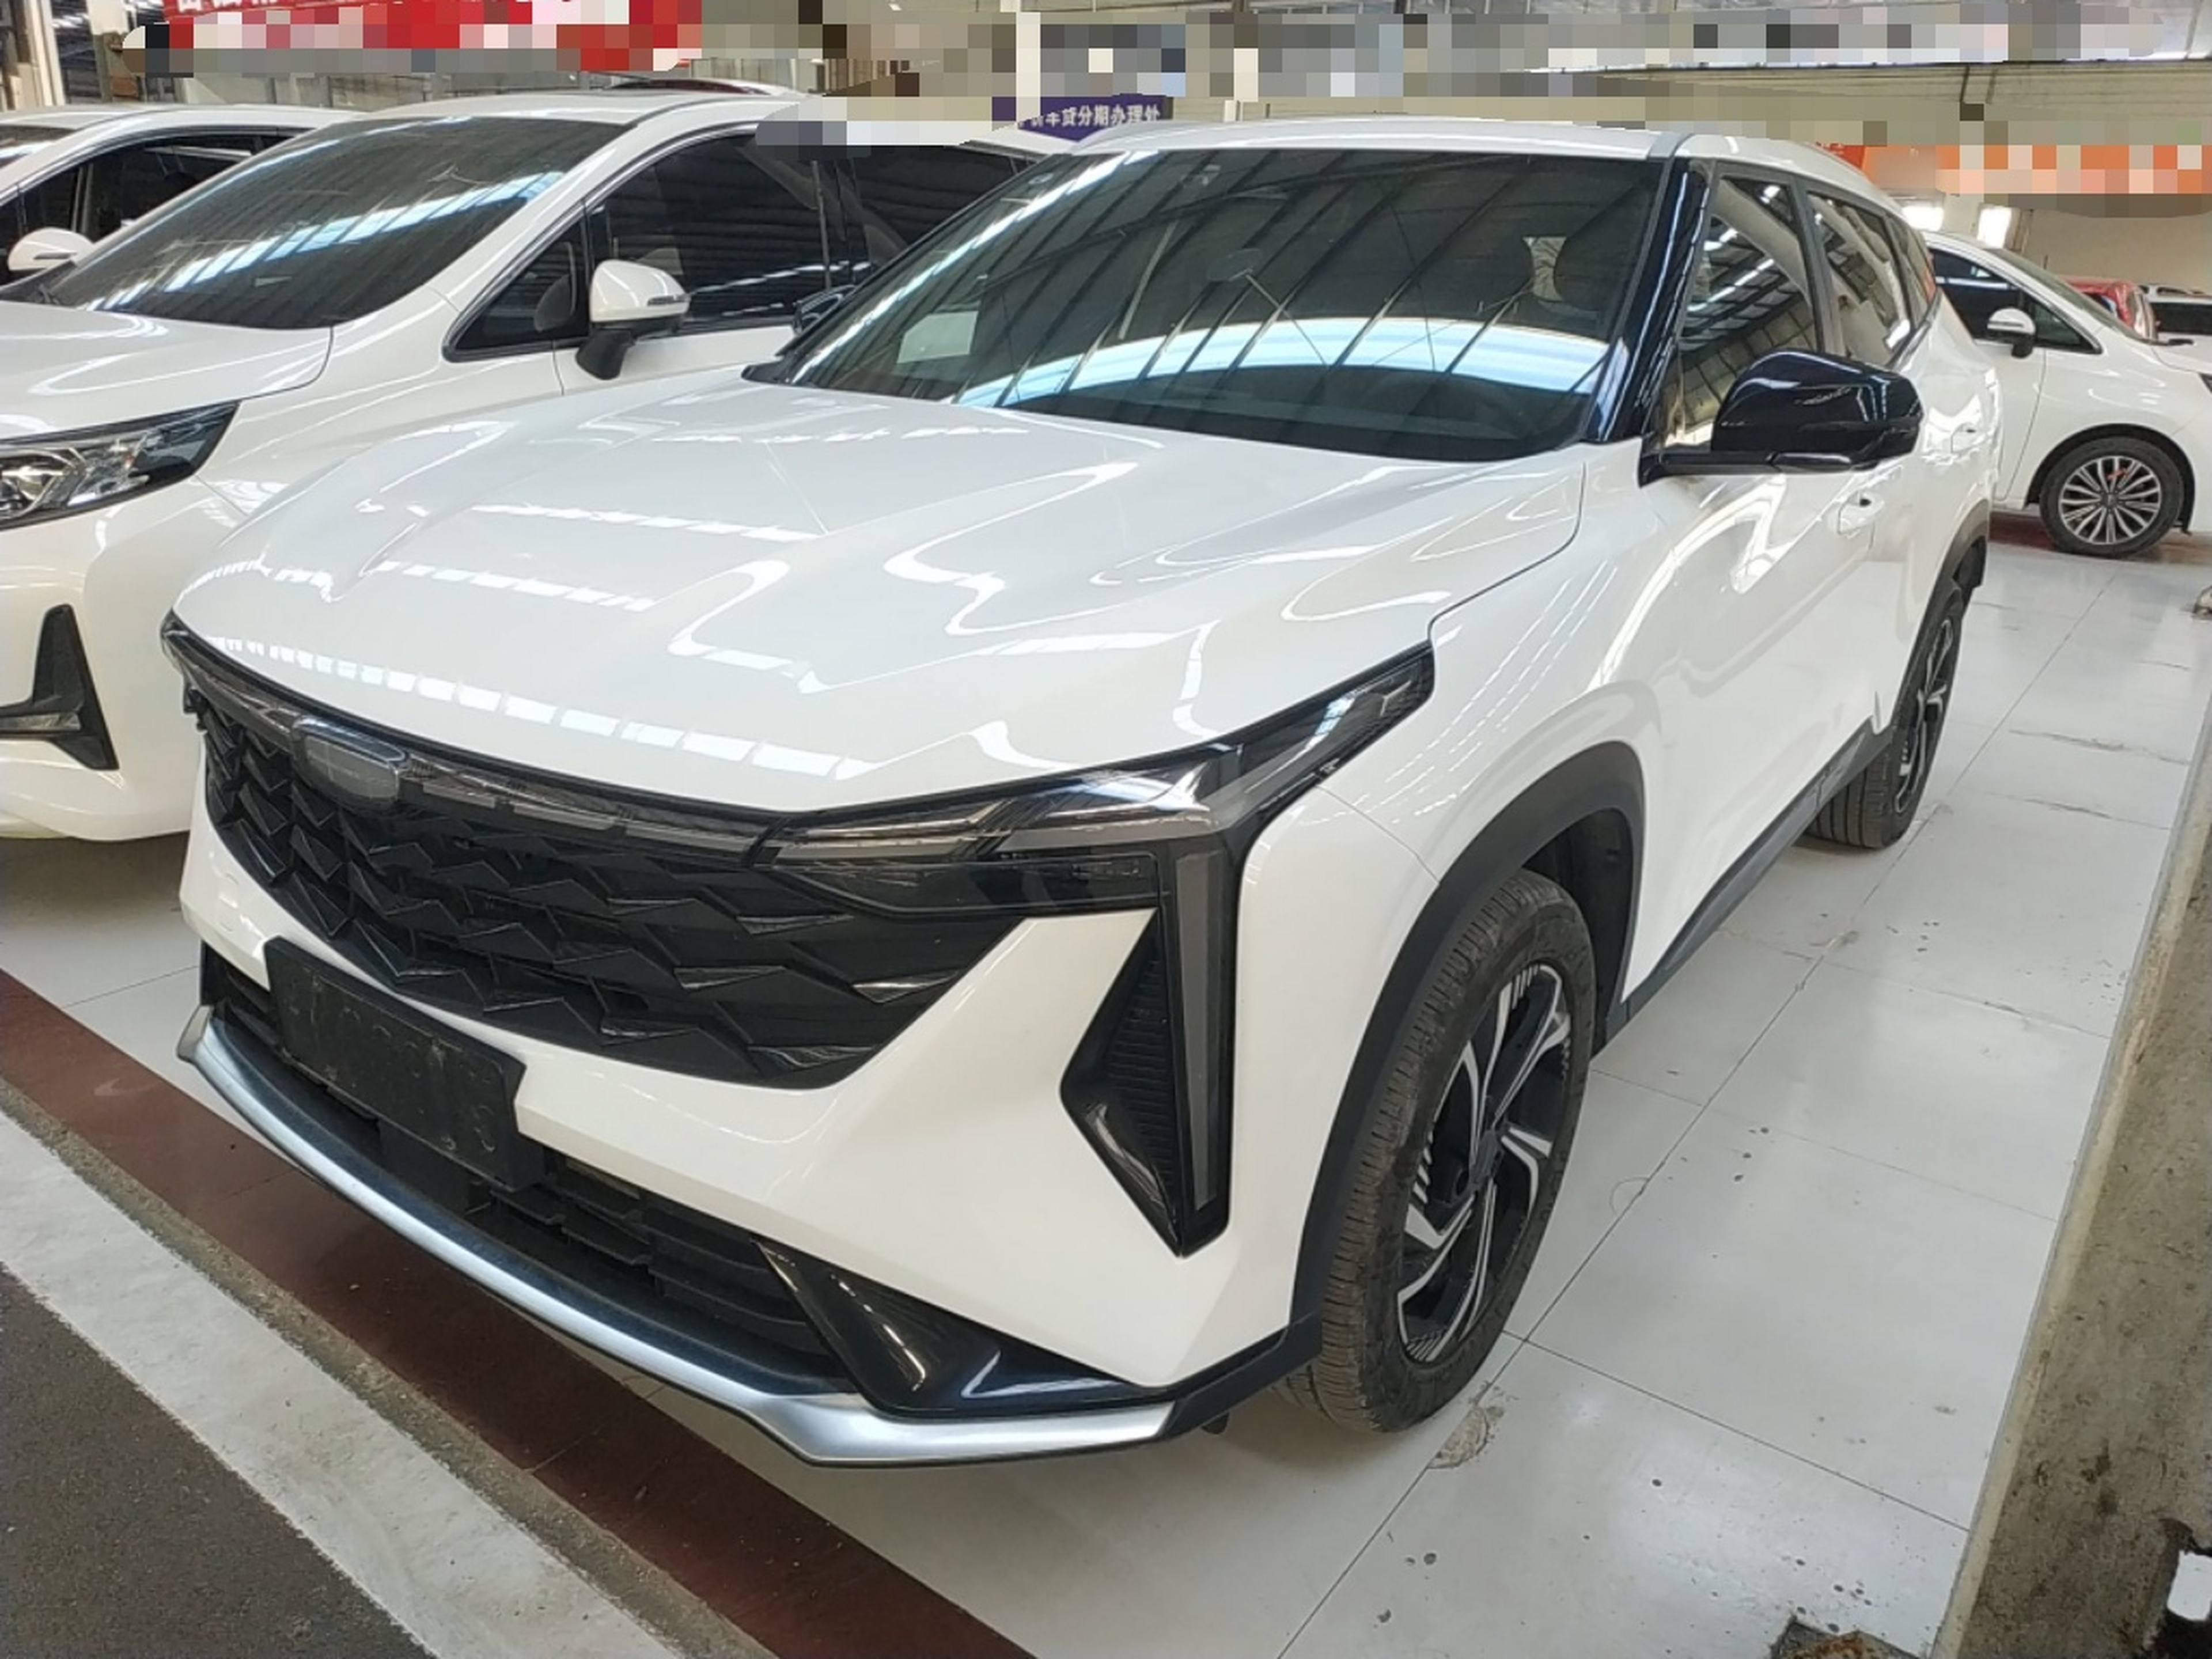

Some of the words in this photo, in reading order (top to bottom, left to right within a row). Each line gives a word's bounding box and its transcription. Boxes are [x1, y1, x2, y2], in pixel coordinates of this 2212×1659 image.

[1019, 104, 1160, 128] 车贷分期办理处
